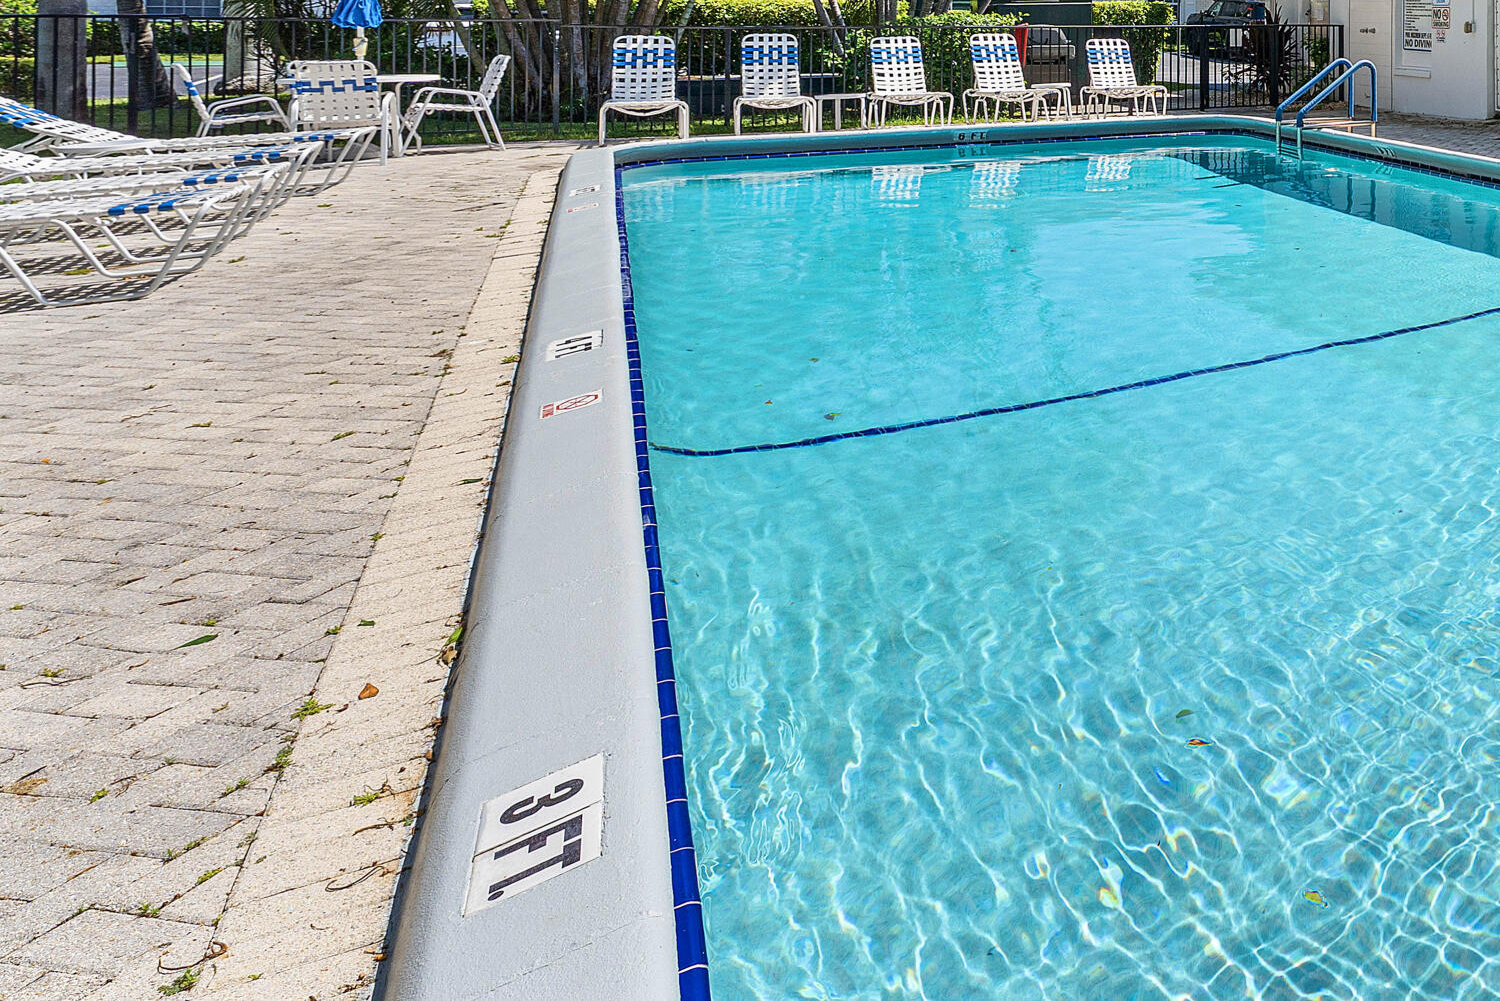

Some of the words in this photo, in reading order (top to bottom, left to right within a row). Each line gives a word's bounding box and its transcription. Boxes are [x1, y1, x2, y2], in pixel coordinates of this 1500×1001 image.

[1432, 9, 1442, 19] NO
[1405, 39, 1413, 47] NO
[958, 132, 966, 141] 6
[499, 778, 585, 825] 3
[488, 814, 583, 902] FT.
